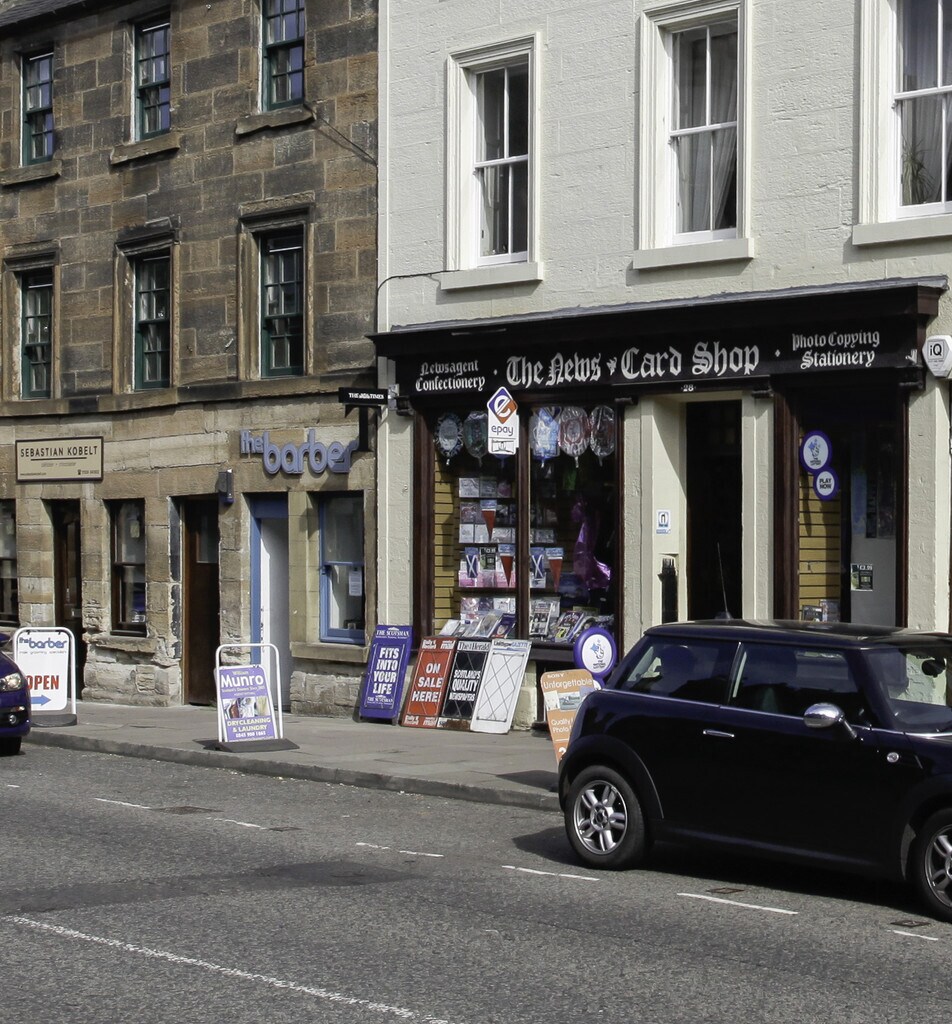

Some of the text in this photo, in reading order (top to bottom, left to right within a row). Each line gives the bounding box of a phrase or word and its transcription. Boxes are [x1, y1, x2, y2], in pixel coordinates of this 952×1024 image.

[792, 330, 880, 351] Photo Copying
[930, 343, 942, 356] iQ
[506, 355, 543, 388] The
[545, 352, 601, 386] News
[621, 347, 682, 379] Card
[691, 341, 760, 377] Shop
[800, 349, 875, 369] Stationery
[419, 359, 479, 376] Newsagent
[415, 375, 485, 391] Confectionery
[682, 384, 694, 392] 28
[491, 425, 514, 436] epay
[20, 446, 98, 457] SEBASTIAN KOBELT
[28, 637, 67, 648] barber
[379, 647, 400, 659] FITS
[376, 659, 398, 671] INTO
[425, 663, 440, 674] ON
[26, 675, 59, 691] OPEN
[220, 675, 264, 688] Munro
[373, 671, 397, 683] YOUR
[418, 677, 443, 688] SALE
[373, 683, 392, 695] LIFE
[452, 679, 479, 691] QUALITY
[543, 678, 593, 689] Unforgettable
[449, 692, 476, 702] NEWSPAPERS
[239, 724, 268, 732] LAUNDRY
